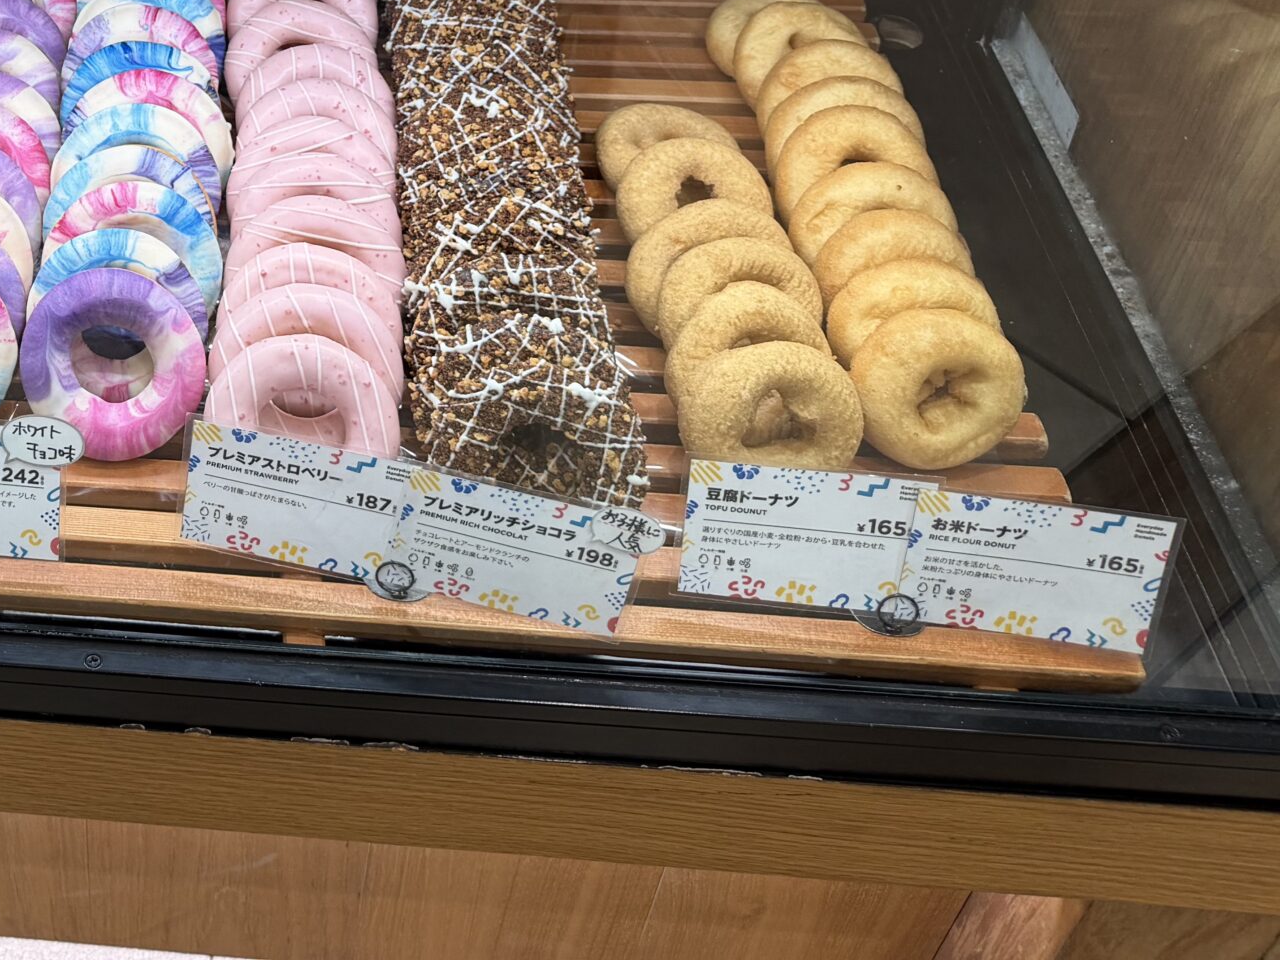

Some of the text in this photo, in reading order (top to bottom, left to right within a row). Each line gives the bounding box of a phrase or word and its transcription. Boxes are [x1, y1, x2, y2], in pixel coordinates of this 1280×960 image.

[12, 422, 62, 440] ホワイト
[27, 442, 76, 462] チョコ味
[206, 460, 300, 486] PREMIUM STRAWBERRY
[706, 487, 799, 508] 豆腐ドーナツ
[705, 503, 767, 516] TOFU DOUNUT
[419, 509, 528, 542] PREMIUM RICH CHOCOLAT
[931, 517, 1029, 540] お米ドーナツ
[701, 536, 782, 549] 身体にやさしいドーナツ
[928, 533, 1017, 550] RICE FLOUR DONUT
